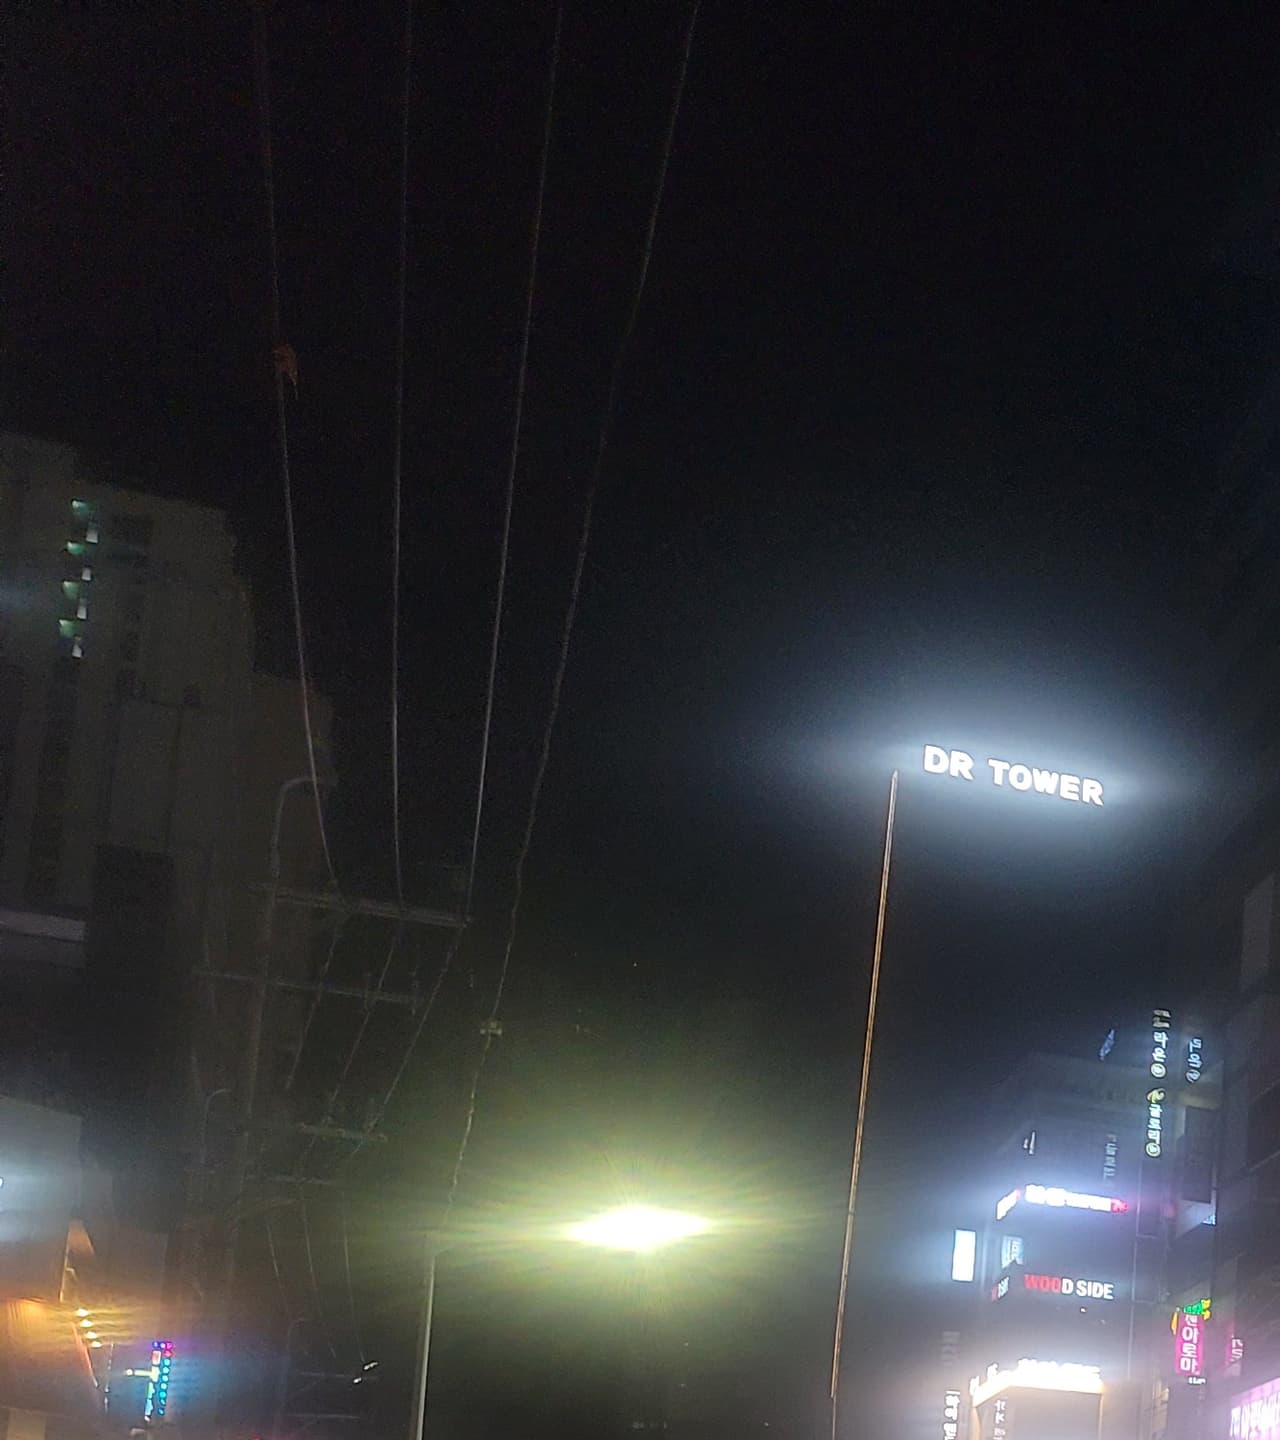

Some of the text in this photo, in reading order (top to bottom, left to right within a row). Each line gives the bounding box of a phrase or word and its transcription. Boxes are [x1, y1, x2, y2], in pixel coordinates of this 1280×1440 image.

[923, 743, 1104, 806] DR TOWER
[1023, 1273, 1074, 1296] WOOD
[1076, 1279, 1115, 1300] SIDE
